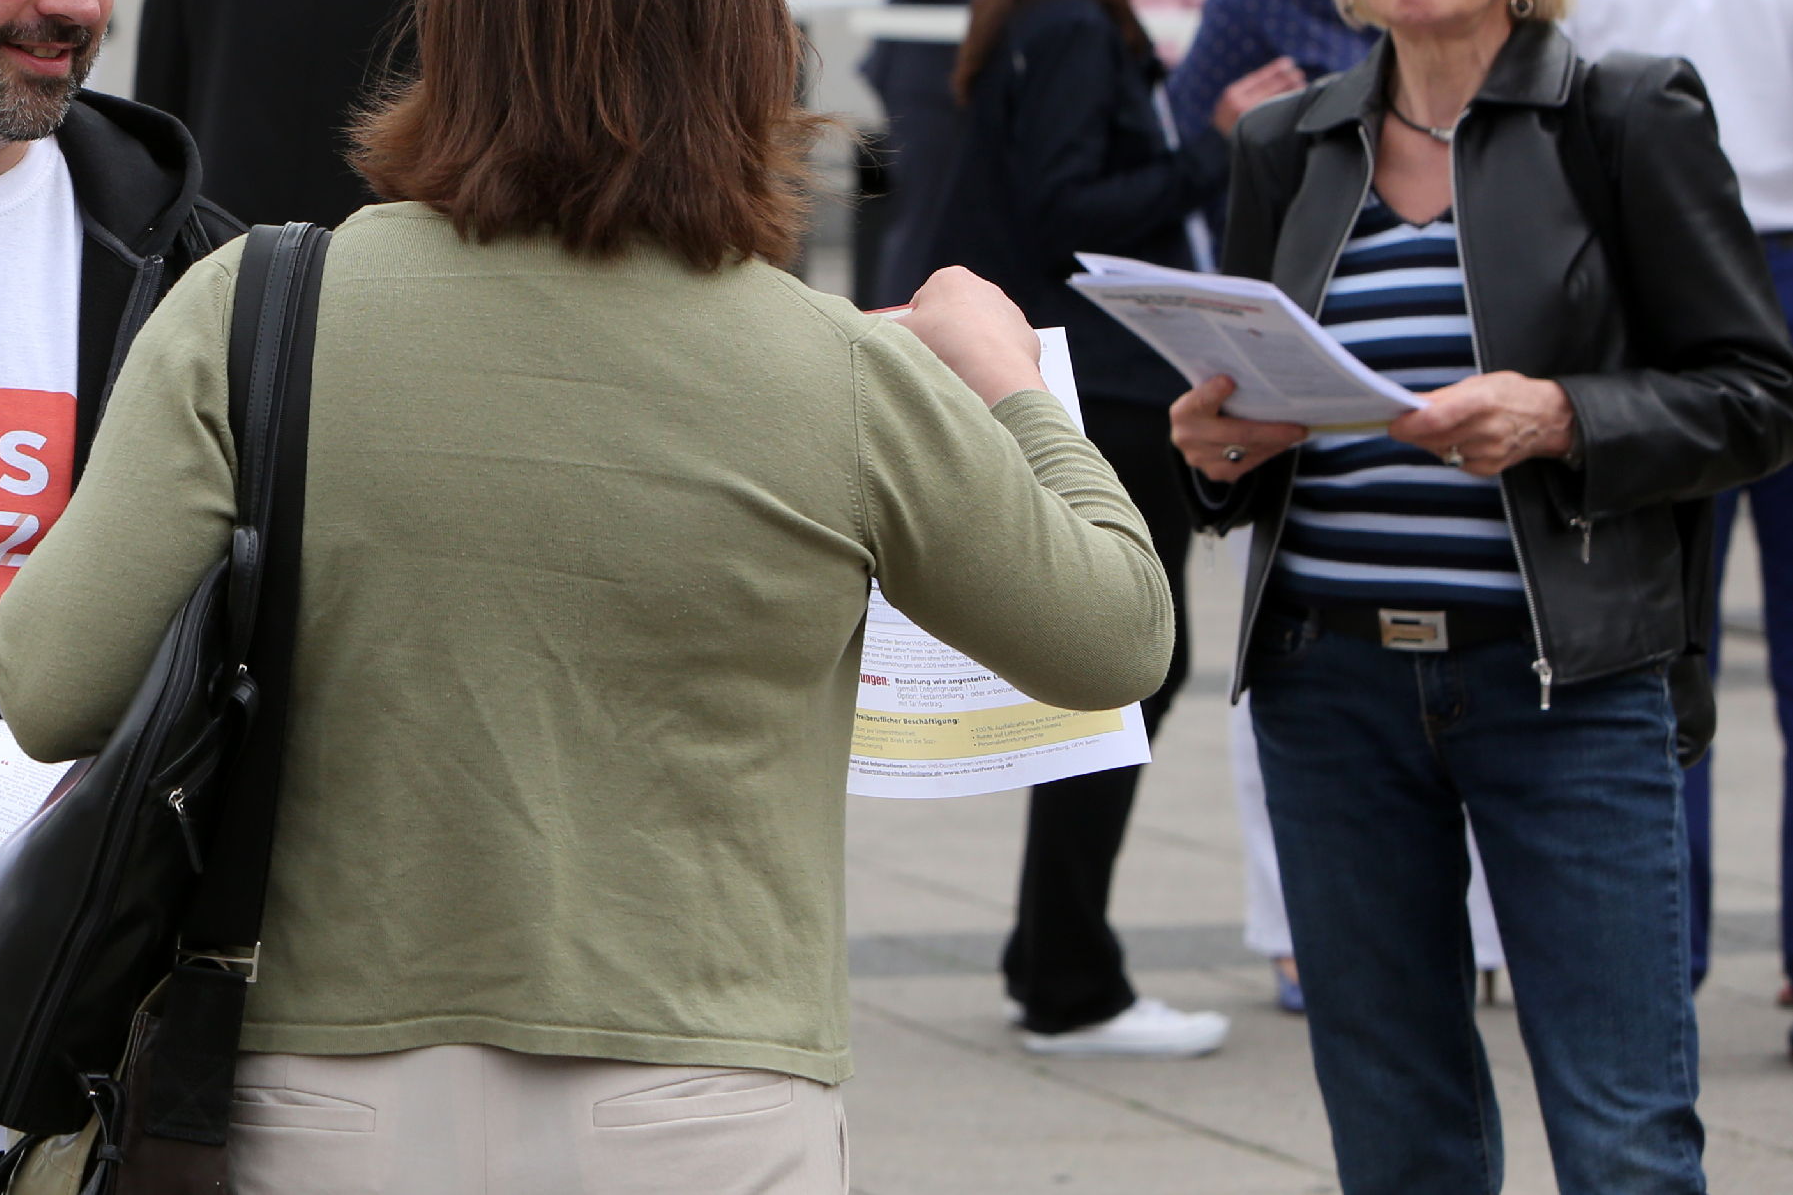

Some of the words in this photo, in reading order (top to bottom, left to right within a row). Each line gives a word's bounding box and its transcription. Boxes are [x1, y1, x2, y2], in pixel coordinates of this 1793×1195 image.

[894, 677, 931, 686] Bezahlung
[933, 677, 947, 685] wie
[948, 675, 991, 685] angestellte
[903, 717, 960, 726] Beschäftigung:
